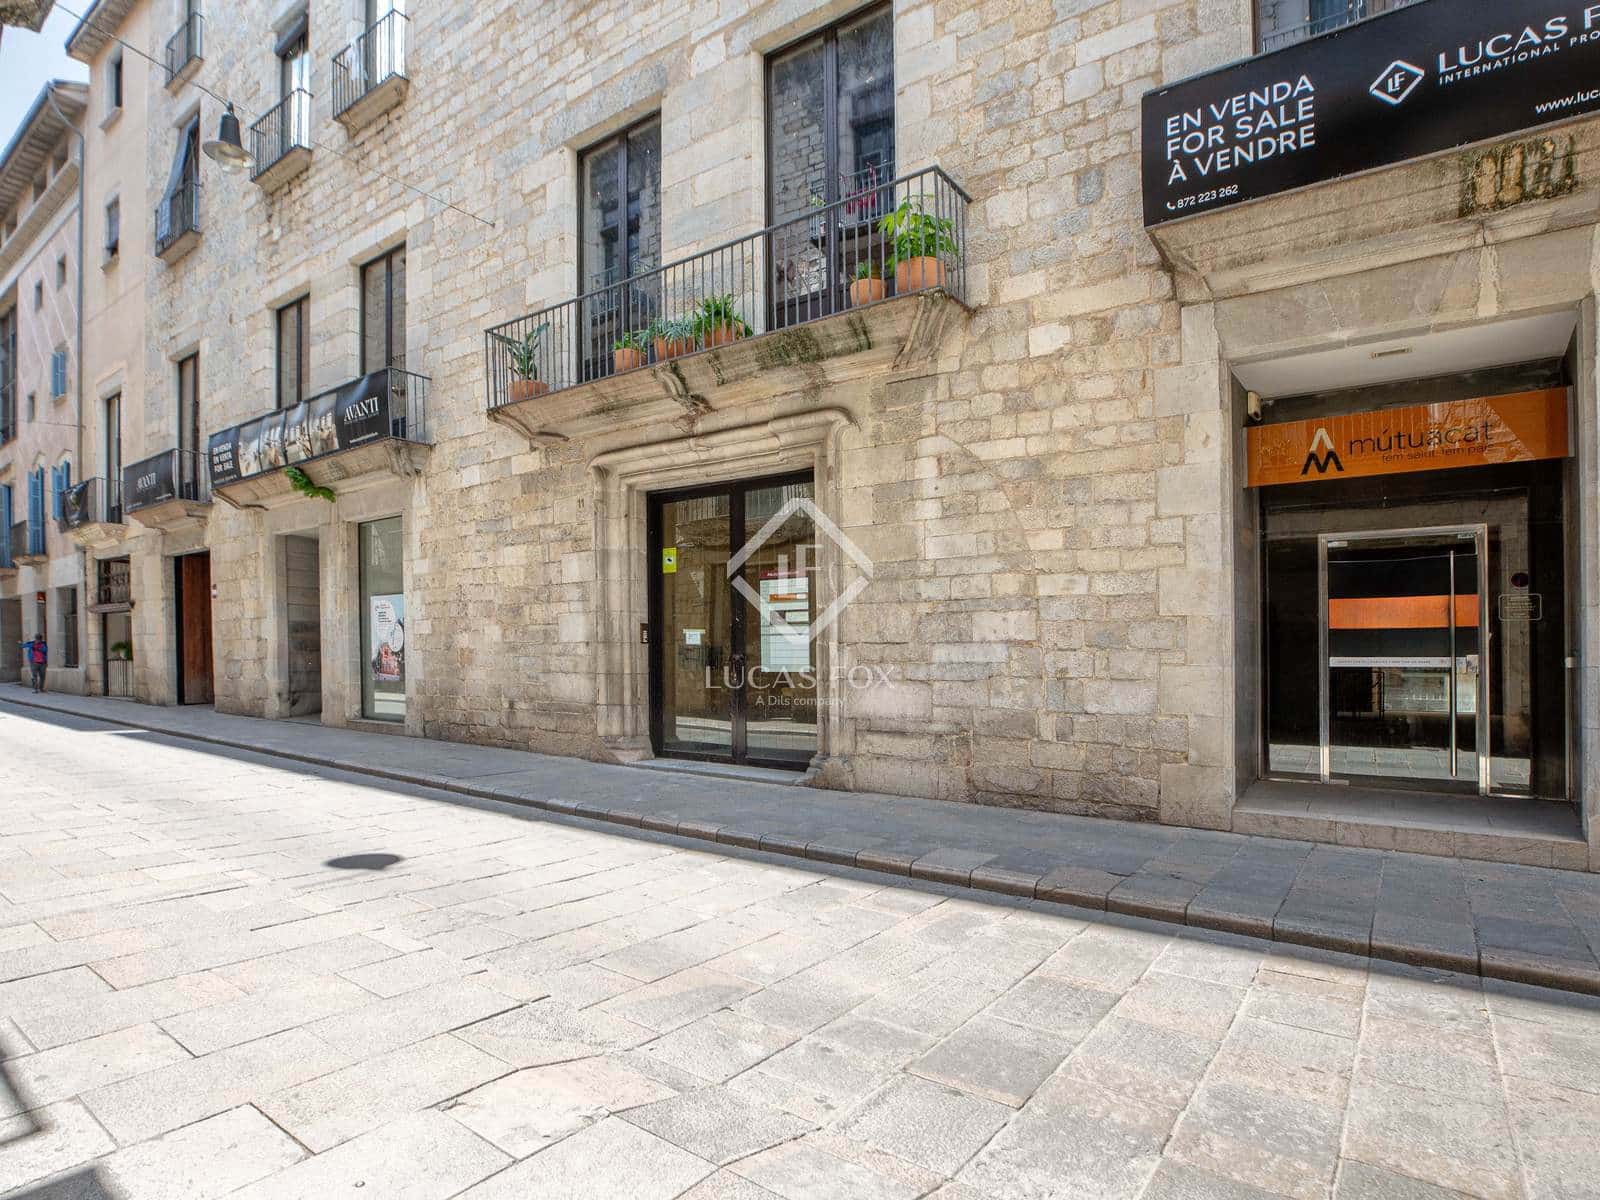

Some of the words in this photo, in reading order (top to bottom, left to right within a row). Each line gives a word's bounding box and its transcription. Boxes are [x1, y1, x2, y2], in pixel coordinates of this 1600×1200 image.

[1437, 16, 1568, 74] LUCAS
[1439, 43, 1560, 86] INTERNATIONAL
[1166, 107, 1201, 136] EN
[1210, 73, 1315, 121] VENDA
[1535, 88, 1600, 114] www.luc
[1166, 124, 1225, 161] FOR
[1235, 95, 1315, 139] SALE
[1167, 159, 1188, 186] À
[1194, 123, 1316, 177] VENDRE
[1177, 196, 1196, 209] 872
[1198, 190, 1217, 204] 223
[1218, 184, 1239, 198] 262
[344, 397, 379, 421] AVANTI
[1350, 420, 1494, 455] mútuacat
